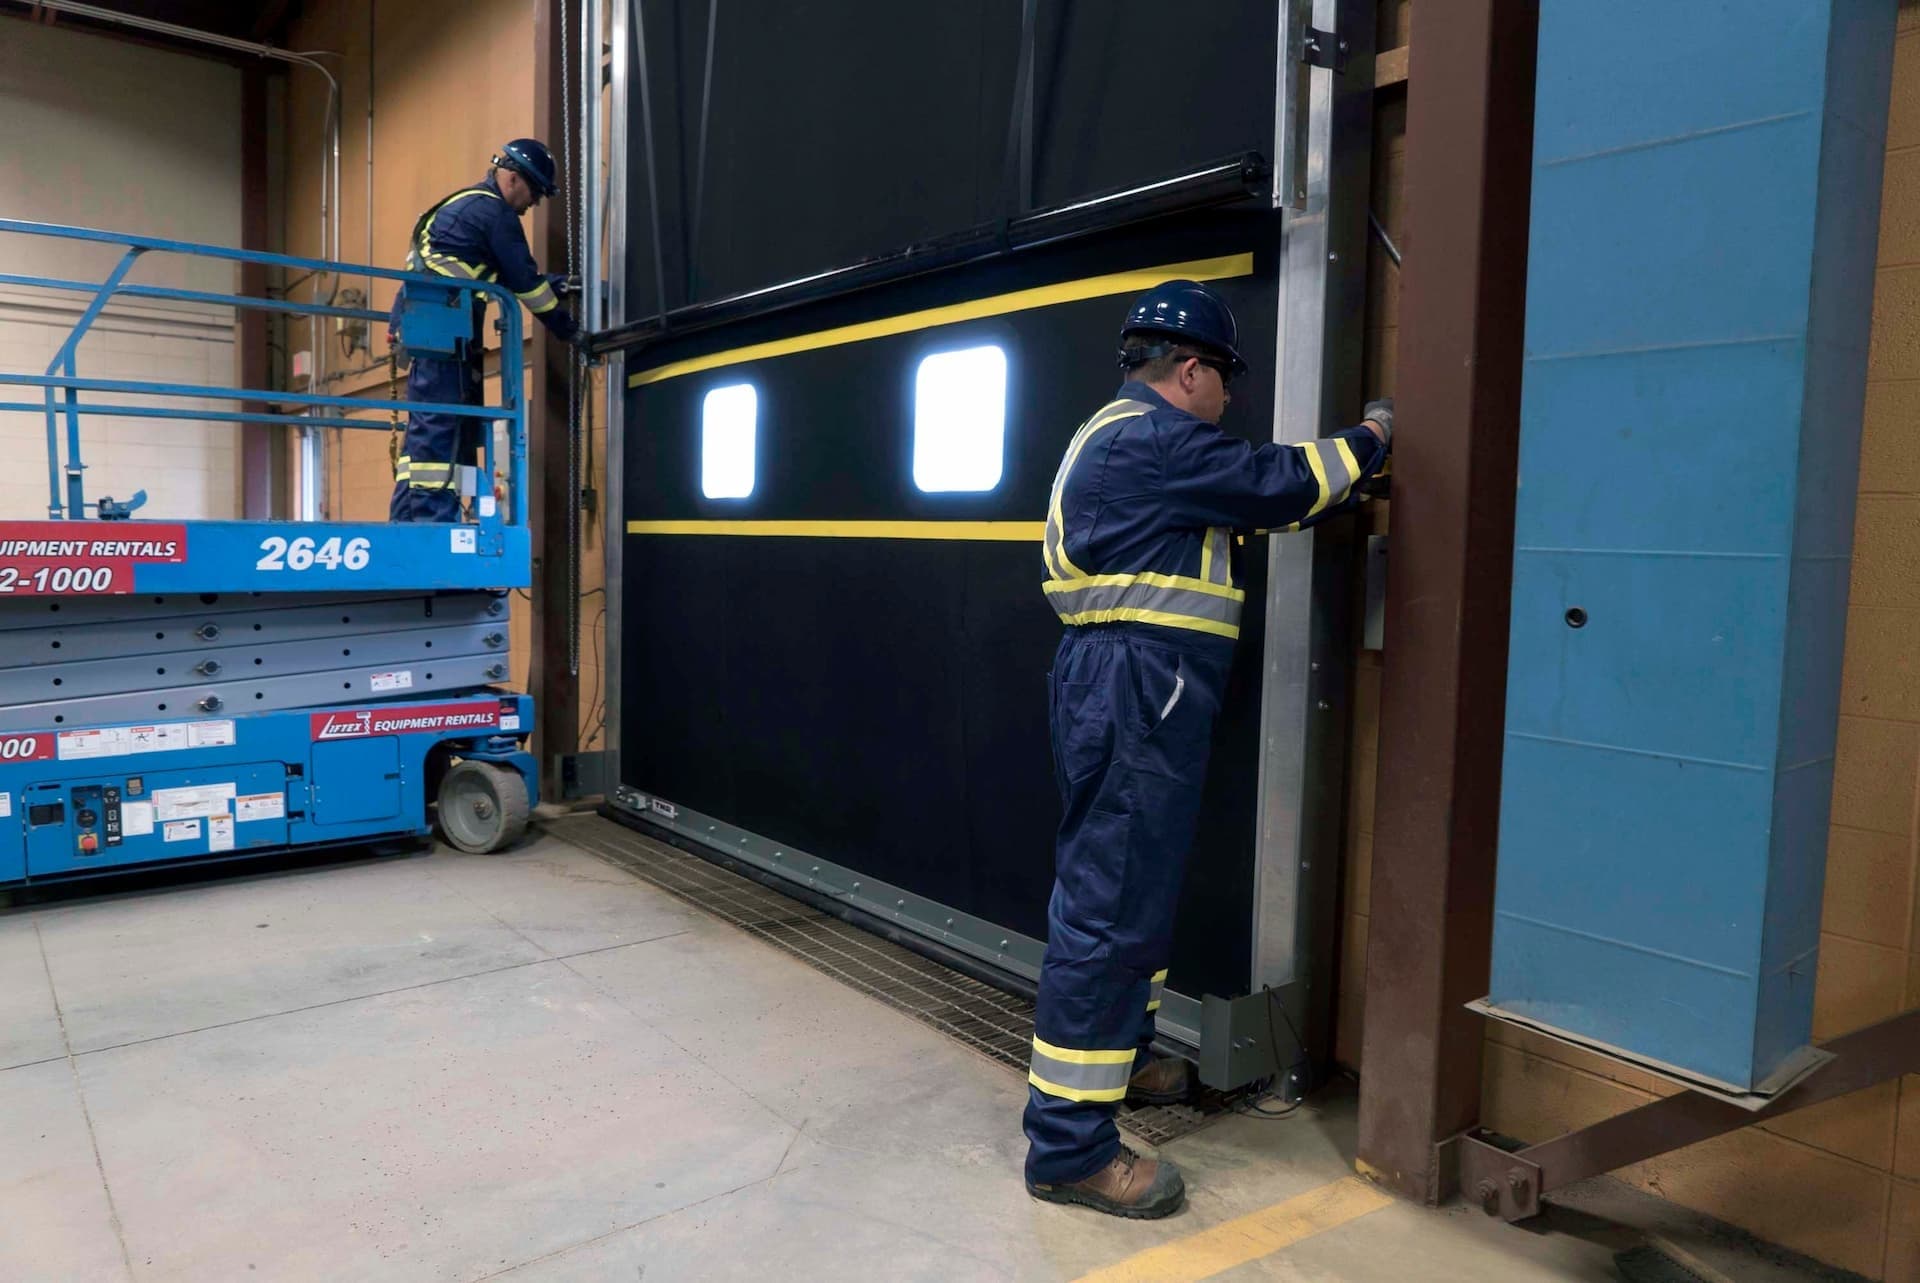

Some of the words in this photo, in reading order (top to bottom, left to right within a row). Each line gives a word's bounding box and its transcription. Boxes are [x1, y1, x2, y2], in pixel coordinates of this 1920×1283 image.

[89, 541, 177, 557] RENTALS
[256, 536, 371, 571] 2646
[0, 567, 112, 592] 2-1000
[318, 714, 370, 739] LIFTEX
[374, 717, 444, 731] EQUIPMENT
[445, 713, 494, 725] RENTALS
[0, 737, 37, 759] 00
